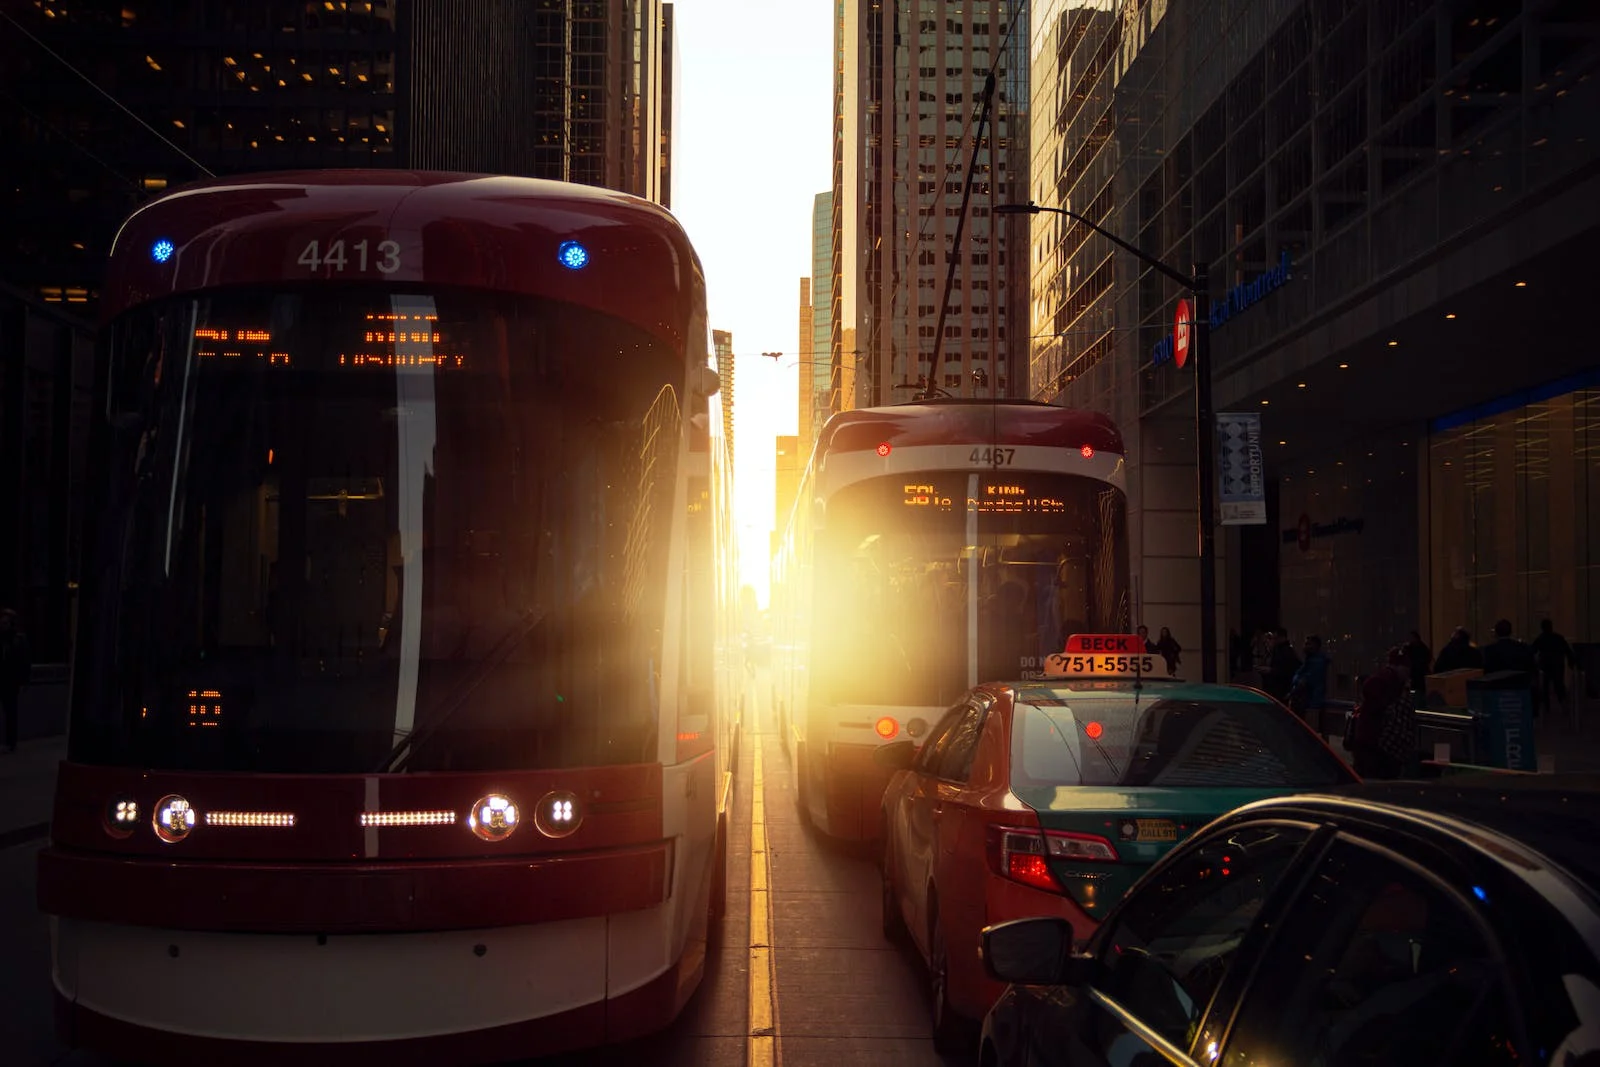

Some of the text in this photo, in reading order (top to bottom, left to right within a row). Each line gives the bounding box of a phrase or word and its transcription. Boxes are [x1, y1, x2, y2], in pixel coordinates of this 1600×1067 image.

[297, 239, 401, 274] 4413
[969, 448, 1016, 466] 4467
[1247, 417, 1262, 498] OPPORTUNITY
[1081, 637, 1128, 651] BECK
[1062, 656, 1153, 673] 751-5555
